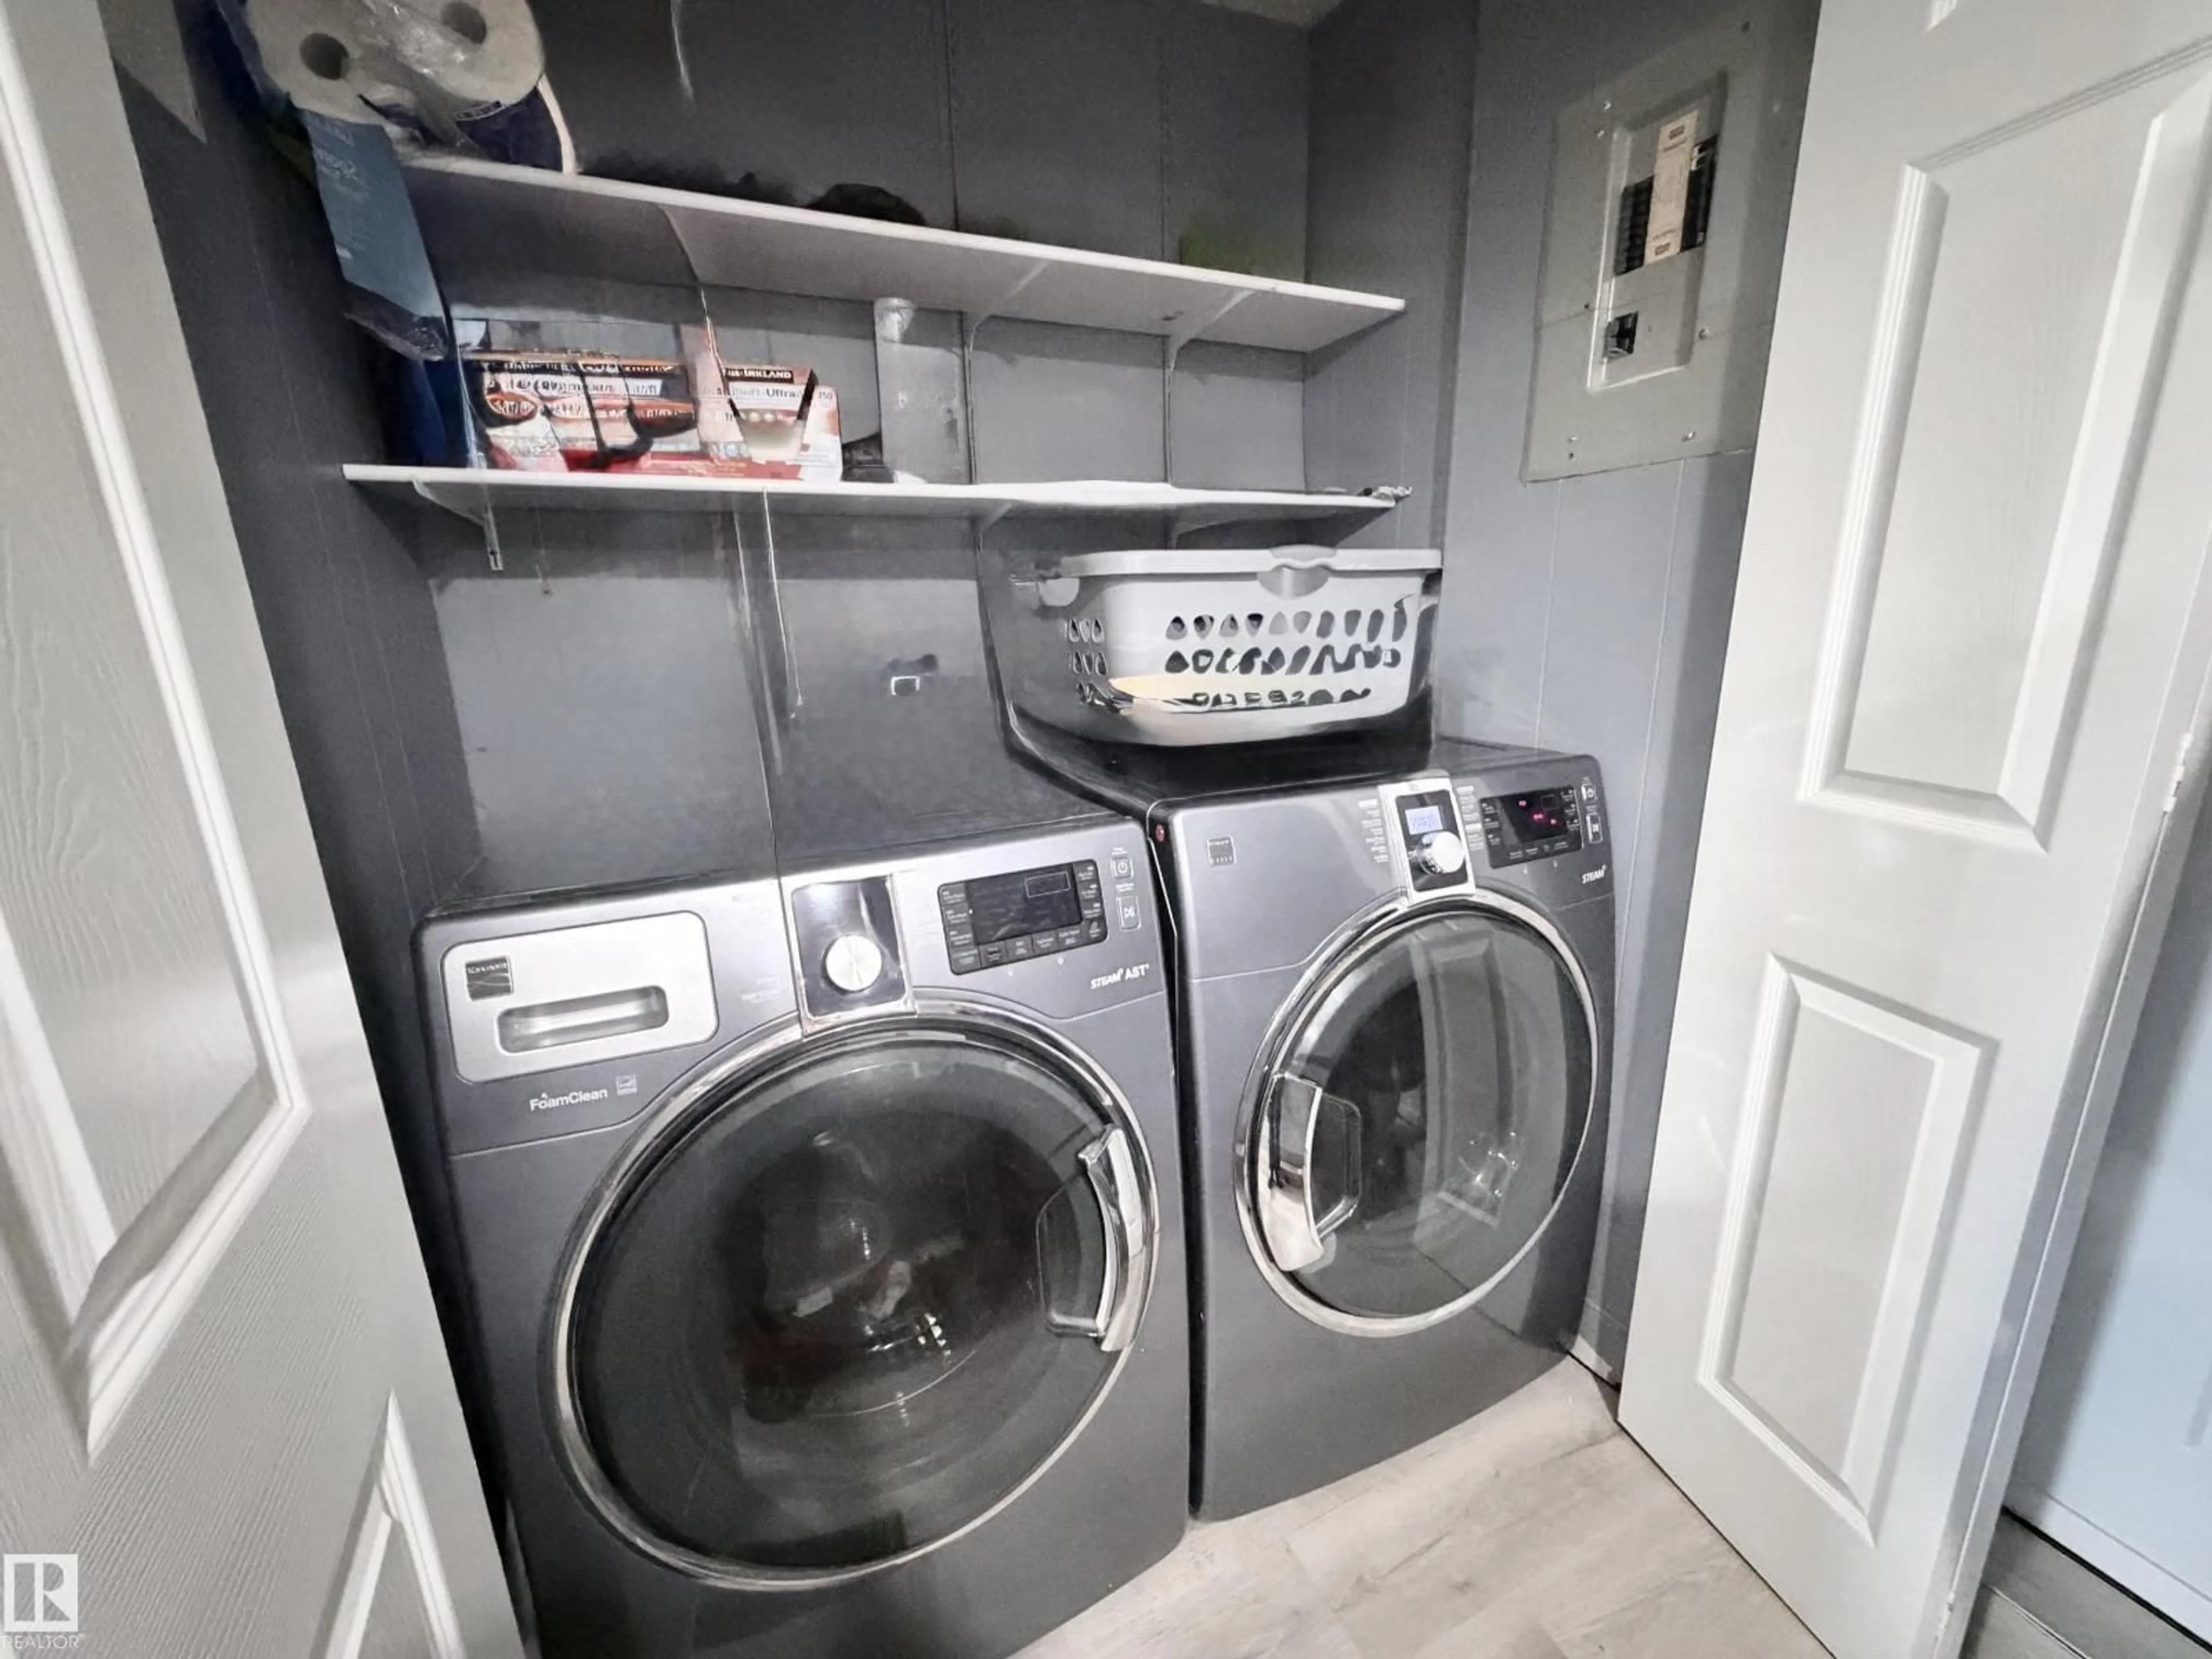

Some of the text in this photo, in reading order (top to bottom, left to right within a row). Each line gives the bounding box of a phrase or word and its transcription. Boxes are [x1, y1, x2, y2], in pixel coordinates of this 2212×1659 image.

[766, 388, 796, 398] Ultra
[1090, 968, 1123, 990] STEAM
[529, 1088, 608, 1111] FoamClean
